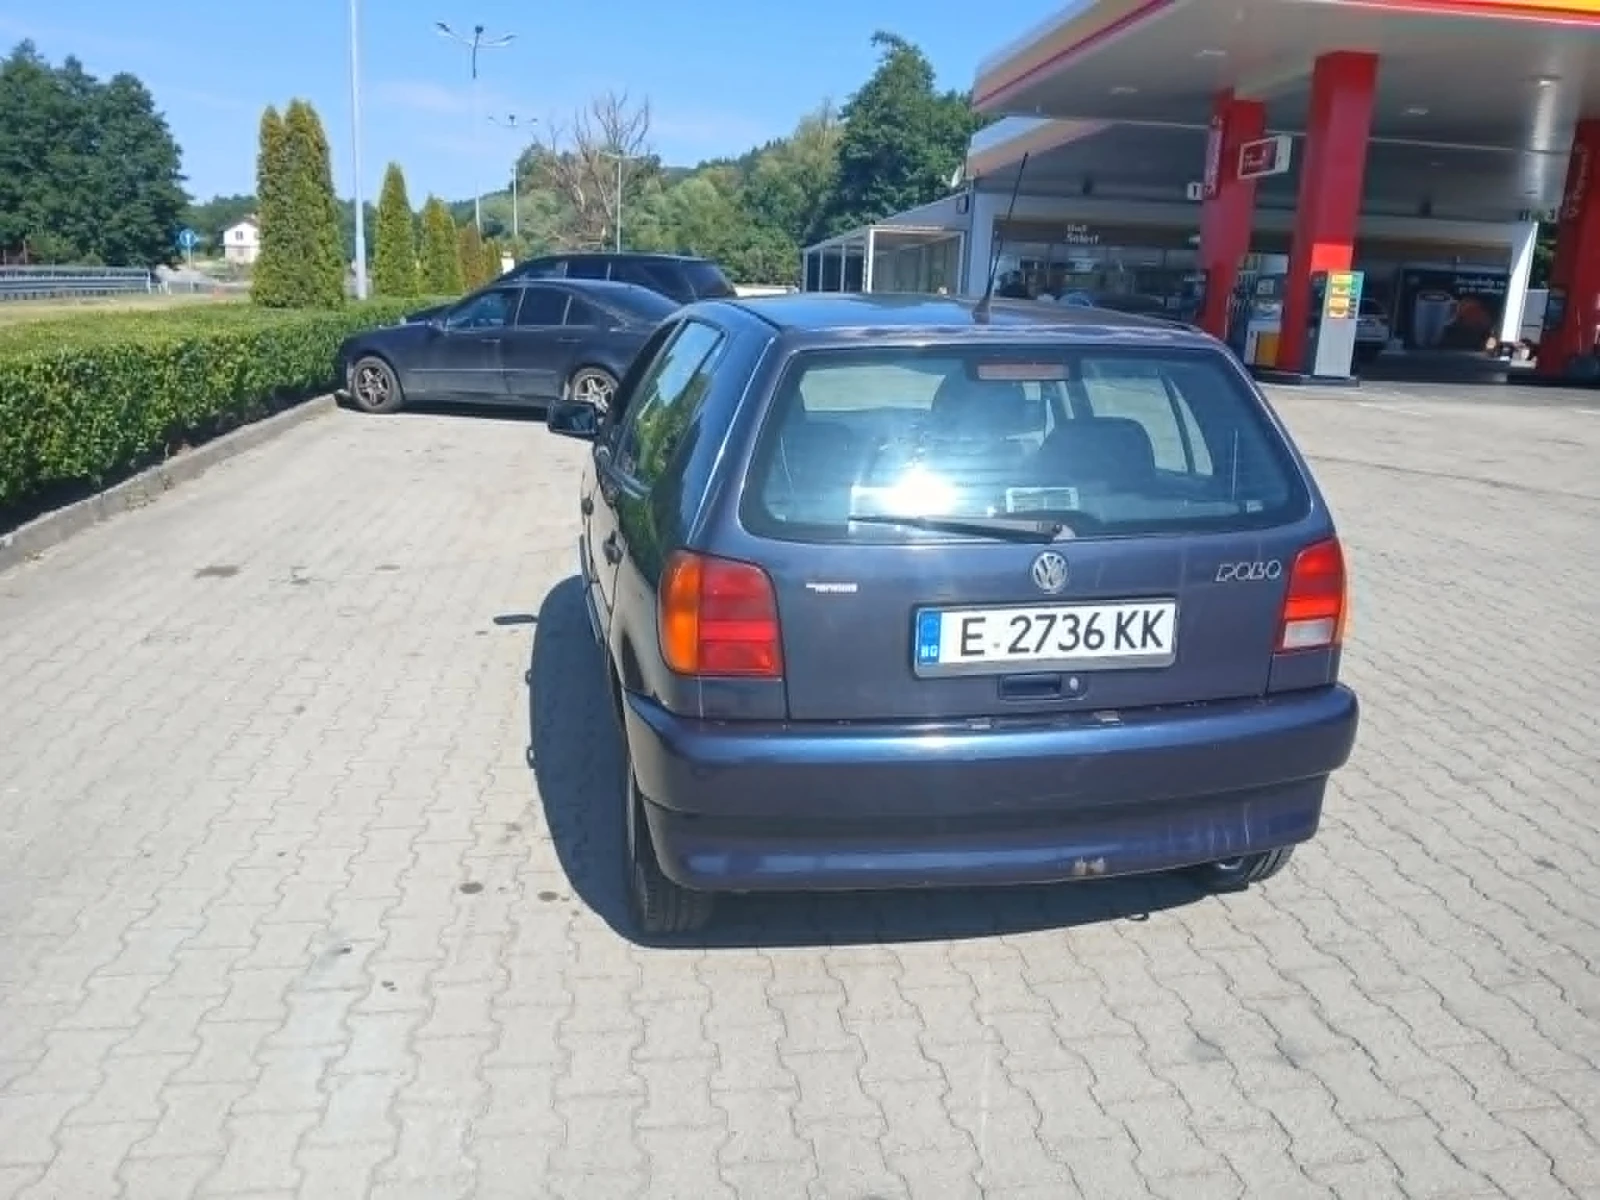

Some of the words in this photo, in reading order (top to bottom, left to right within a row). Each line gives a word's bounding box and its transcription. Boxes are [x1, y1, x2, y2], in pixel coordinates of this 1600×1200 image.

[1215, 560, 1282, 582] POLO
[960, 616, 986, 657] E
[1007, 612, 1105, 654] 2736
[1114, 609, 1166, 650] KK
